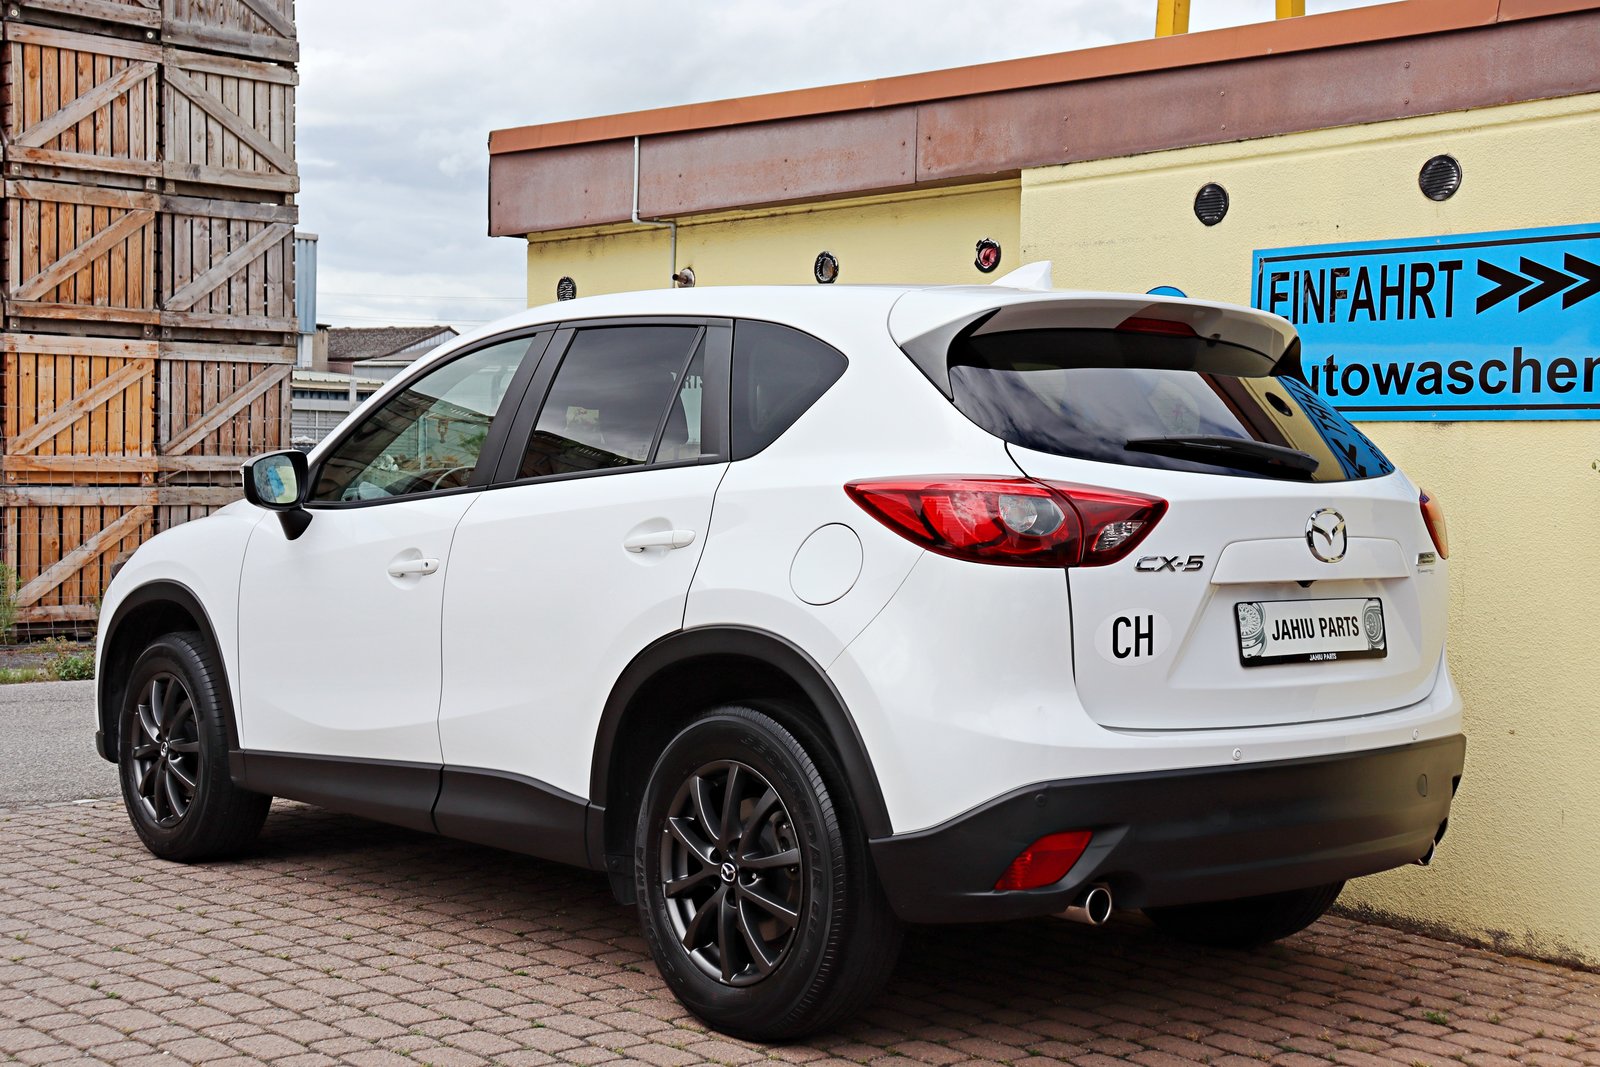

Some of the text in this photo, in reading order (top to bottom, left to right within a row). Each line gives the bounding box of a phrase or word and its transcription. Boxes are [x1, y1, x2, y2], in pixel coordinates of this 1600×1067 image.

[1269, 260, 1464, 325] EINFAHRT
[1135, 555, 1205, 572] CX-5
[1112, 614, 1154, 659] CH
[1272, 616, 1359, 641] JAHIU PARTS
